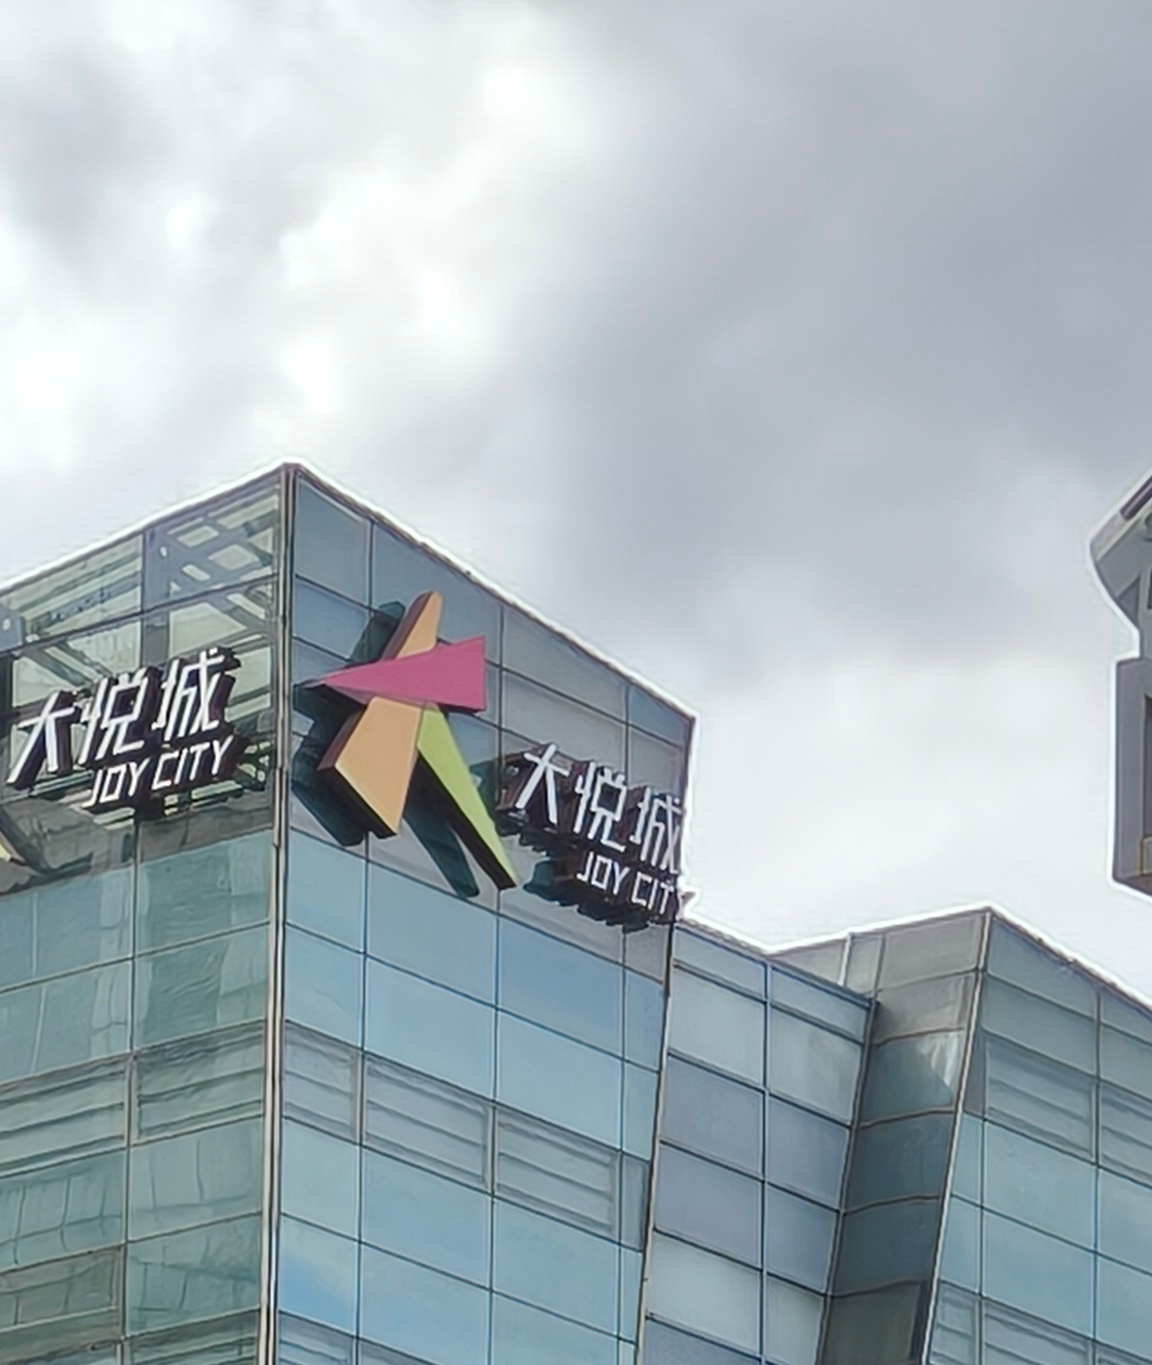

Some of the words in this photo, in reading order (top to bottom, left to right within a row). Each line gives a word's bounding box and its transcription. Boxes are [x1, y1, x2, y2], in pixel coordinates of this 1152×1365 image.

[7, 647, 225, 784] 大悦城
[81, 757, 151, 809] JOY
[151, 734, 234, 790] CITY
[515, 743, 682, 875] 大悦城
[576, 851, 630, 895] JOY
